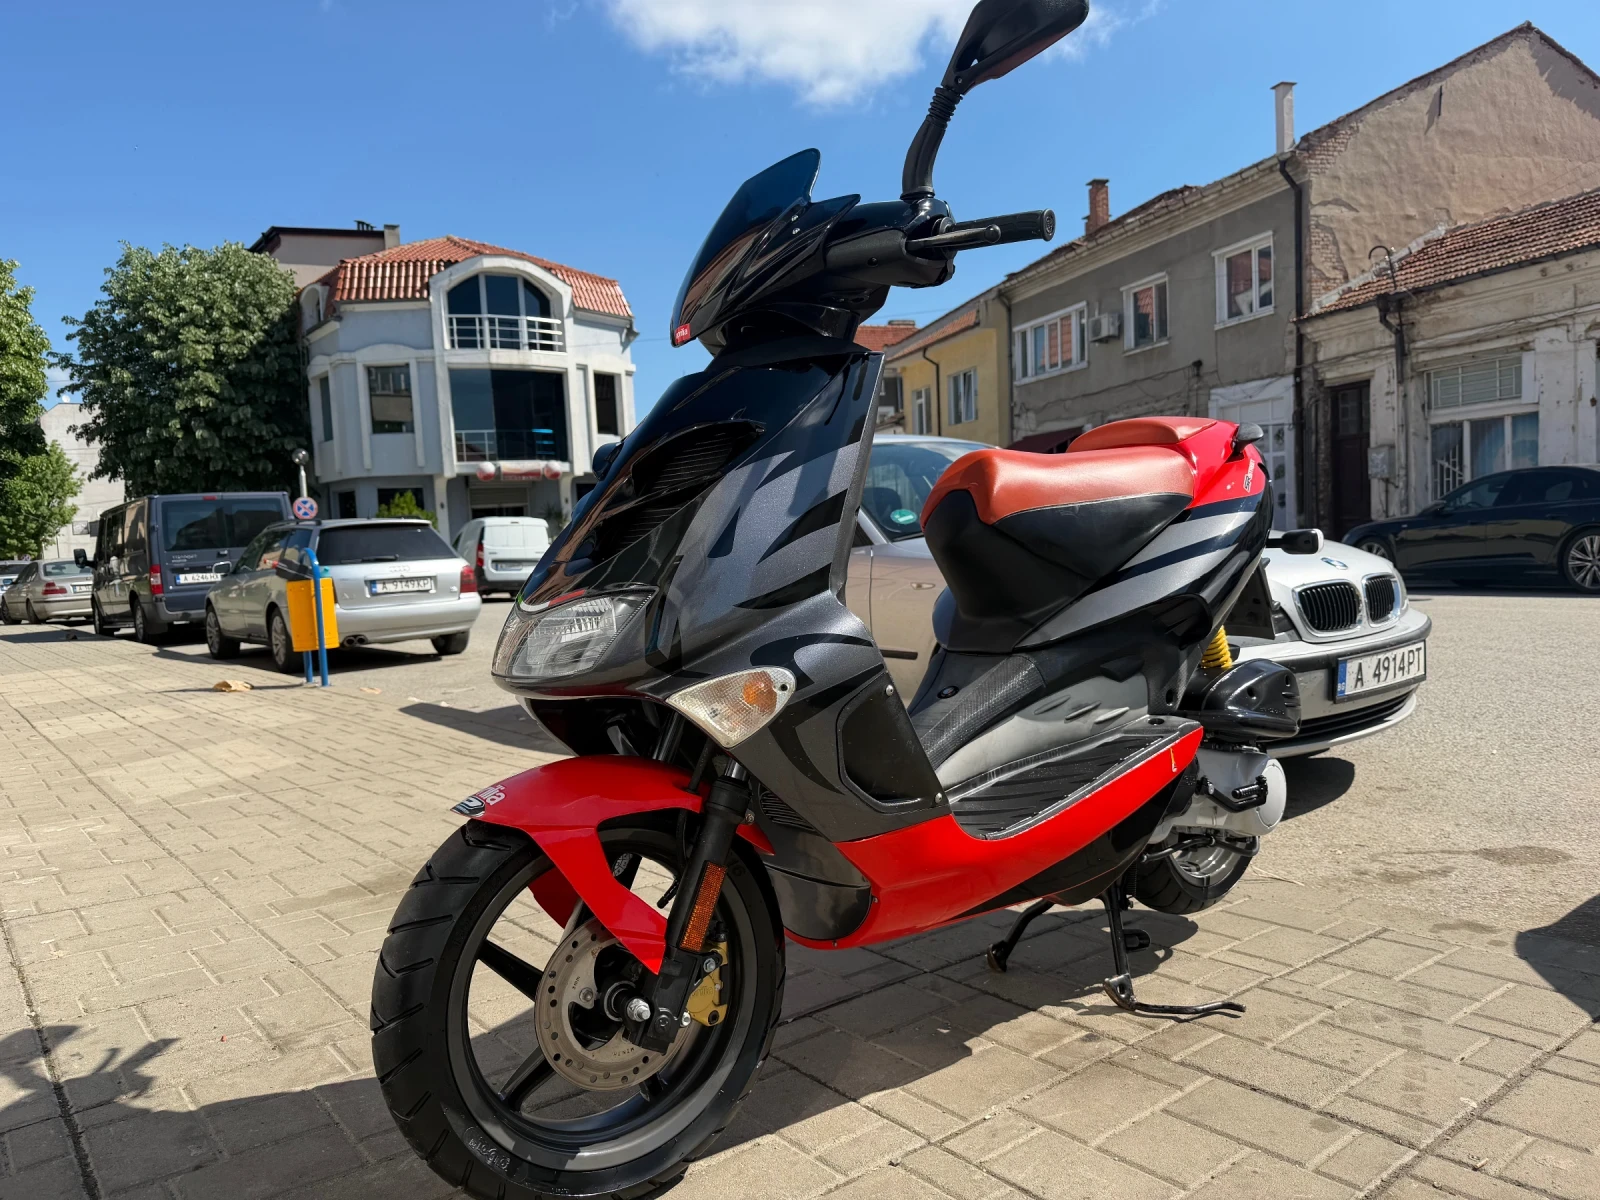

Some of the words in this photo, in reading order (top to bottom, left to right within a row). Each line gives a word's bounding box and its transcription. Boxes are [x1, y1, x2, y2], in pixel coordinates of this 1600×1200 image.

[381, 581, 388, 590] A
[1354, 662, 1364, 689] A
[1372, 647, 1422, 683] 4914PT
[1337, 682, 1346, 691] BG
